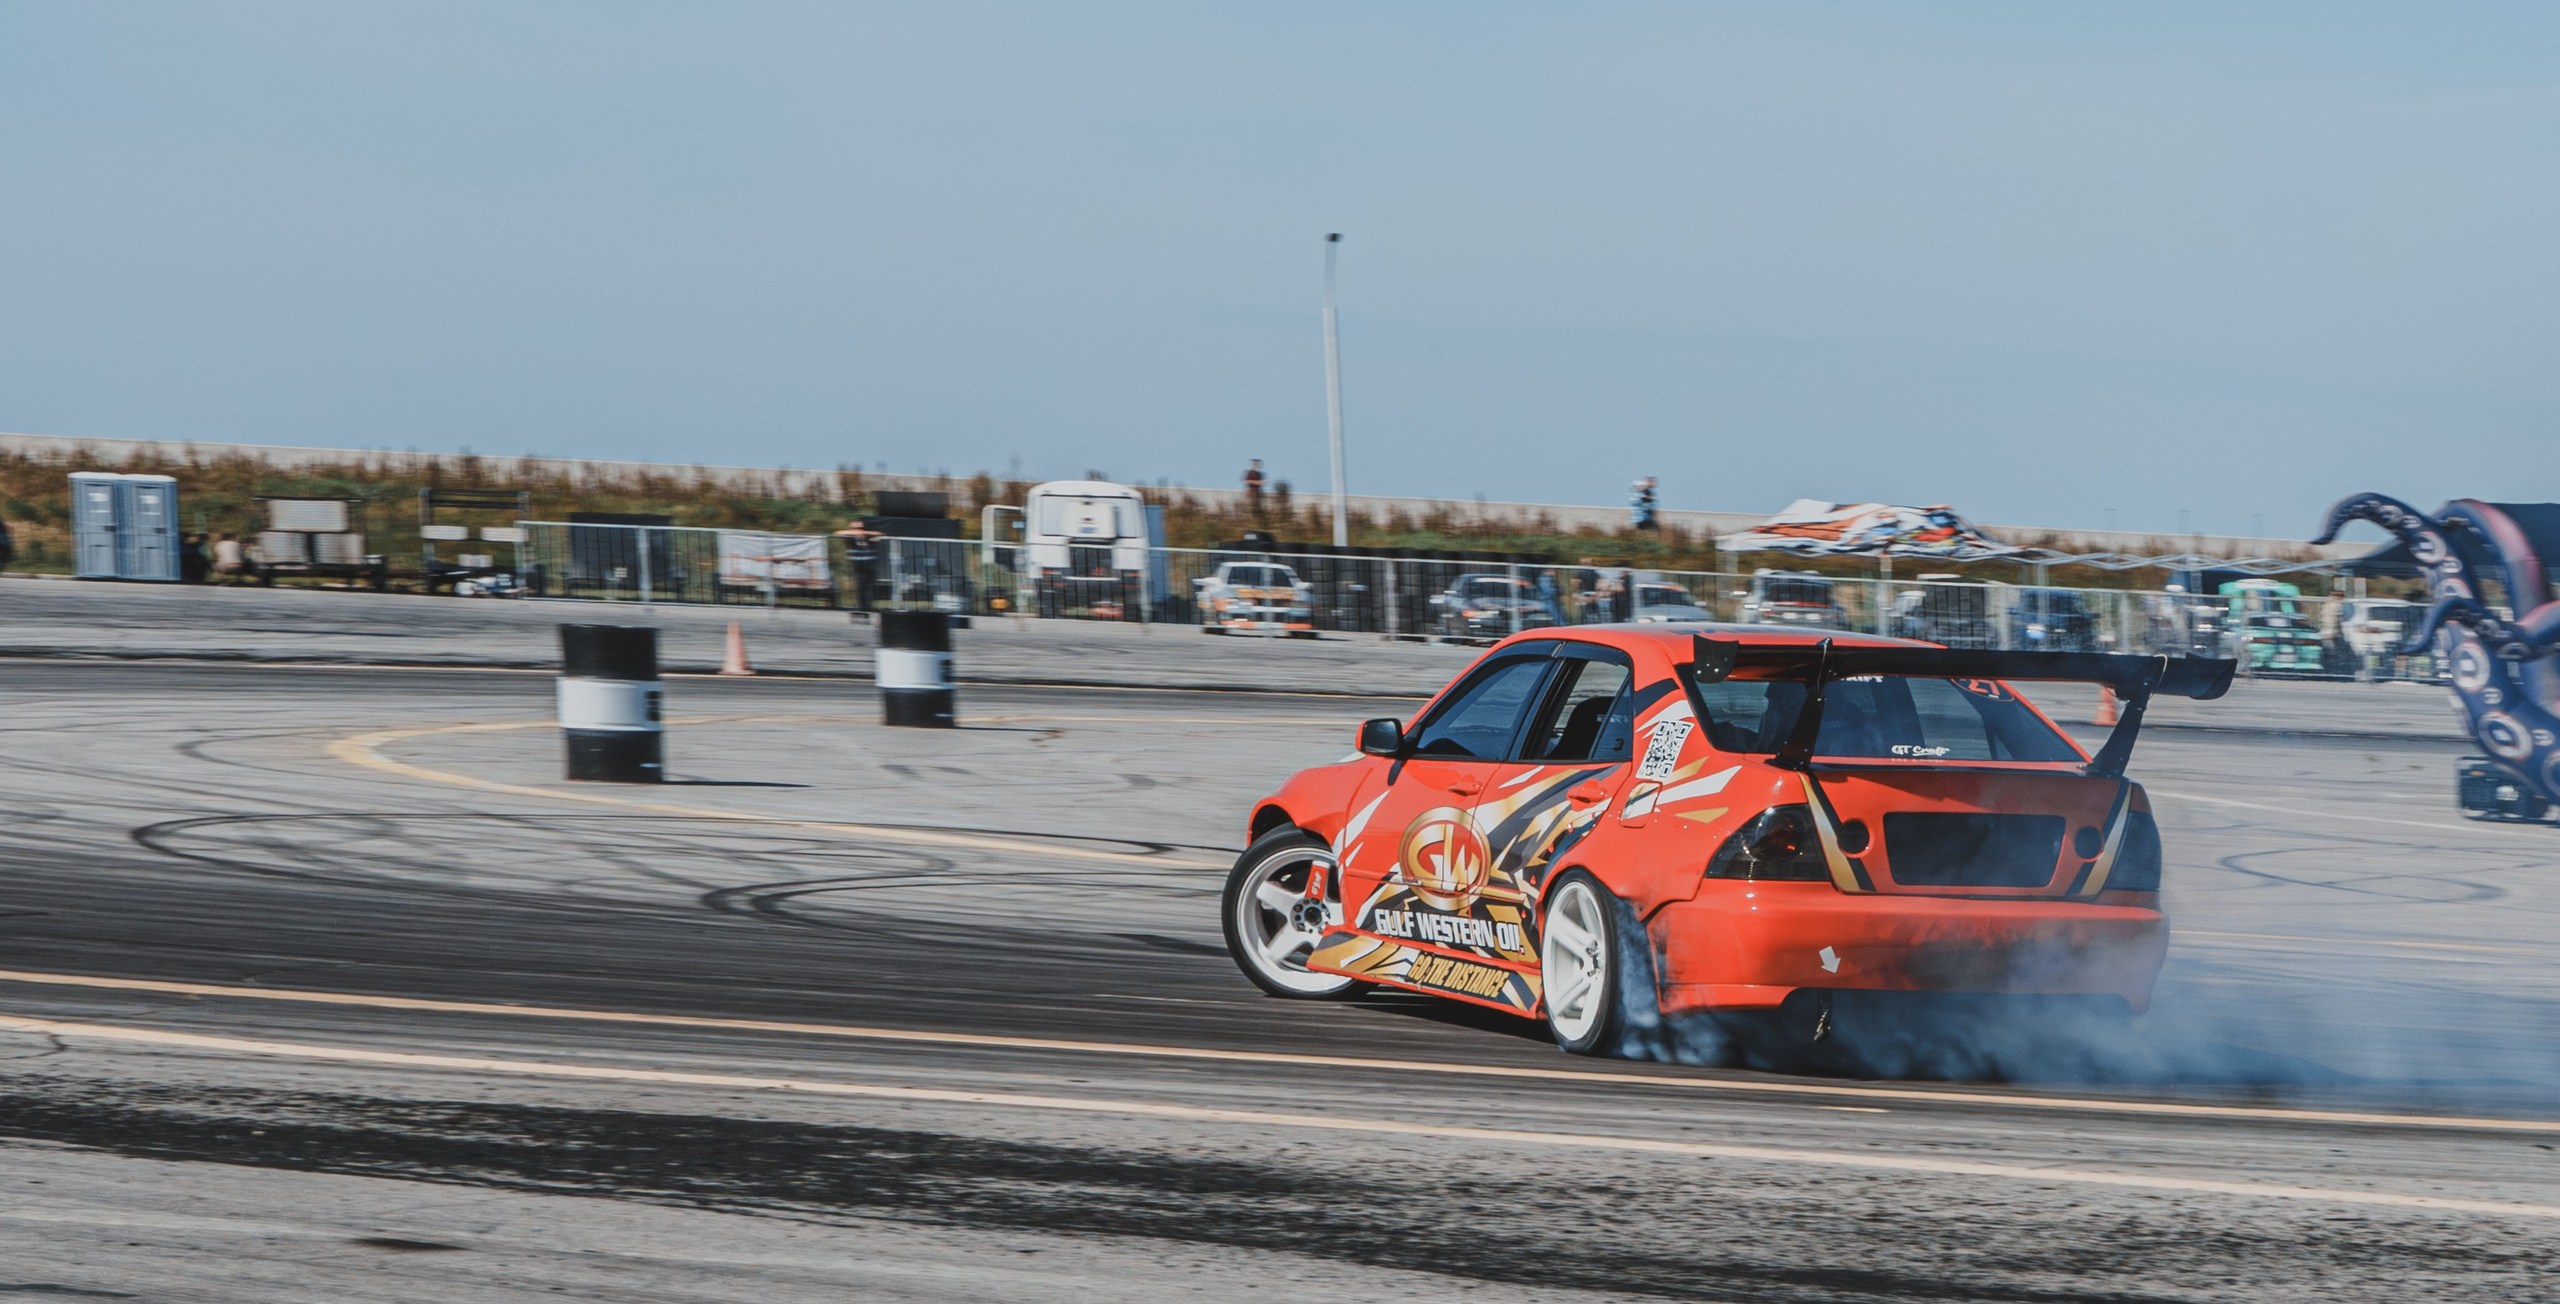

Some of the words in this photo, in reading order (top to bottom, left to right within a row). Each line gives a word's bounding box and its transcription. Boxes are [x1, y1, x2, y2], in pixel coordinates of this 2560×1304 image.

[1891, 744, 1912, 756] GT
[1374, 908, 1415, 938] GULF
[1415, 911, 1495, 949] WESTERN
[1496, 921, 1525, 954] OIL
[1422, 957, 1455, 986] THE
[1443, 961, 1510, 998] DISTANCE
